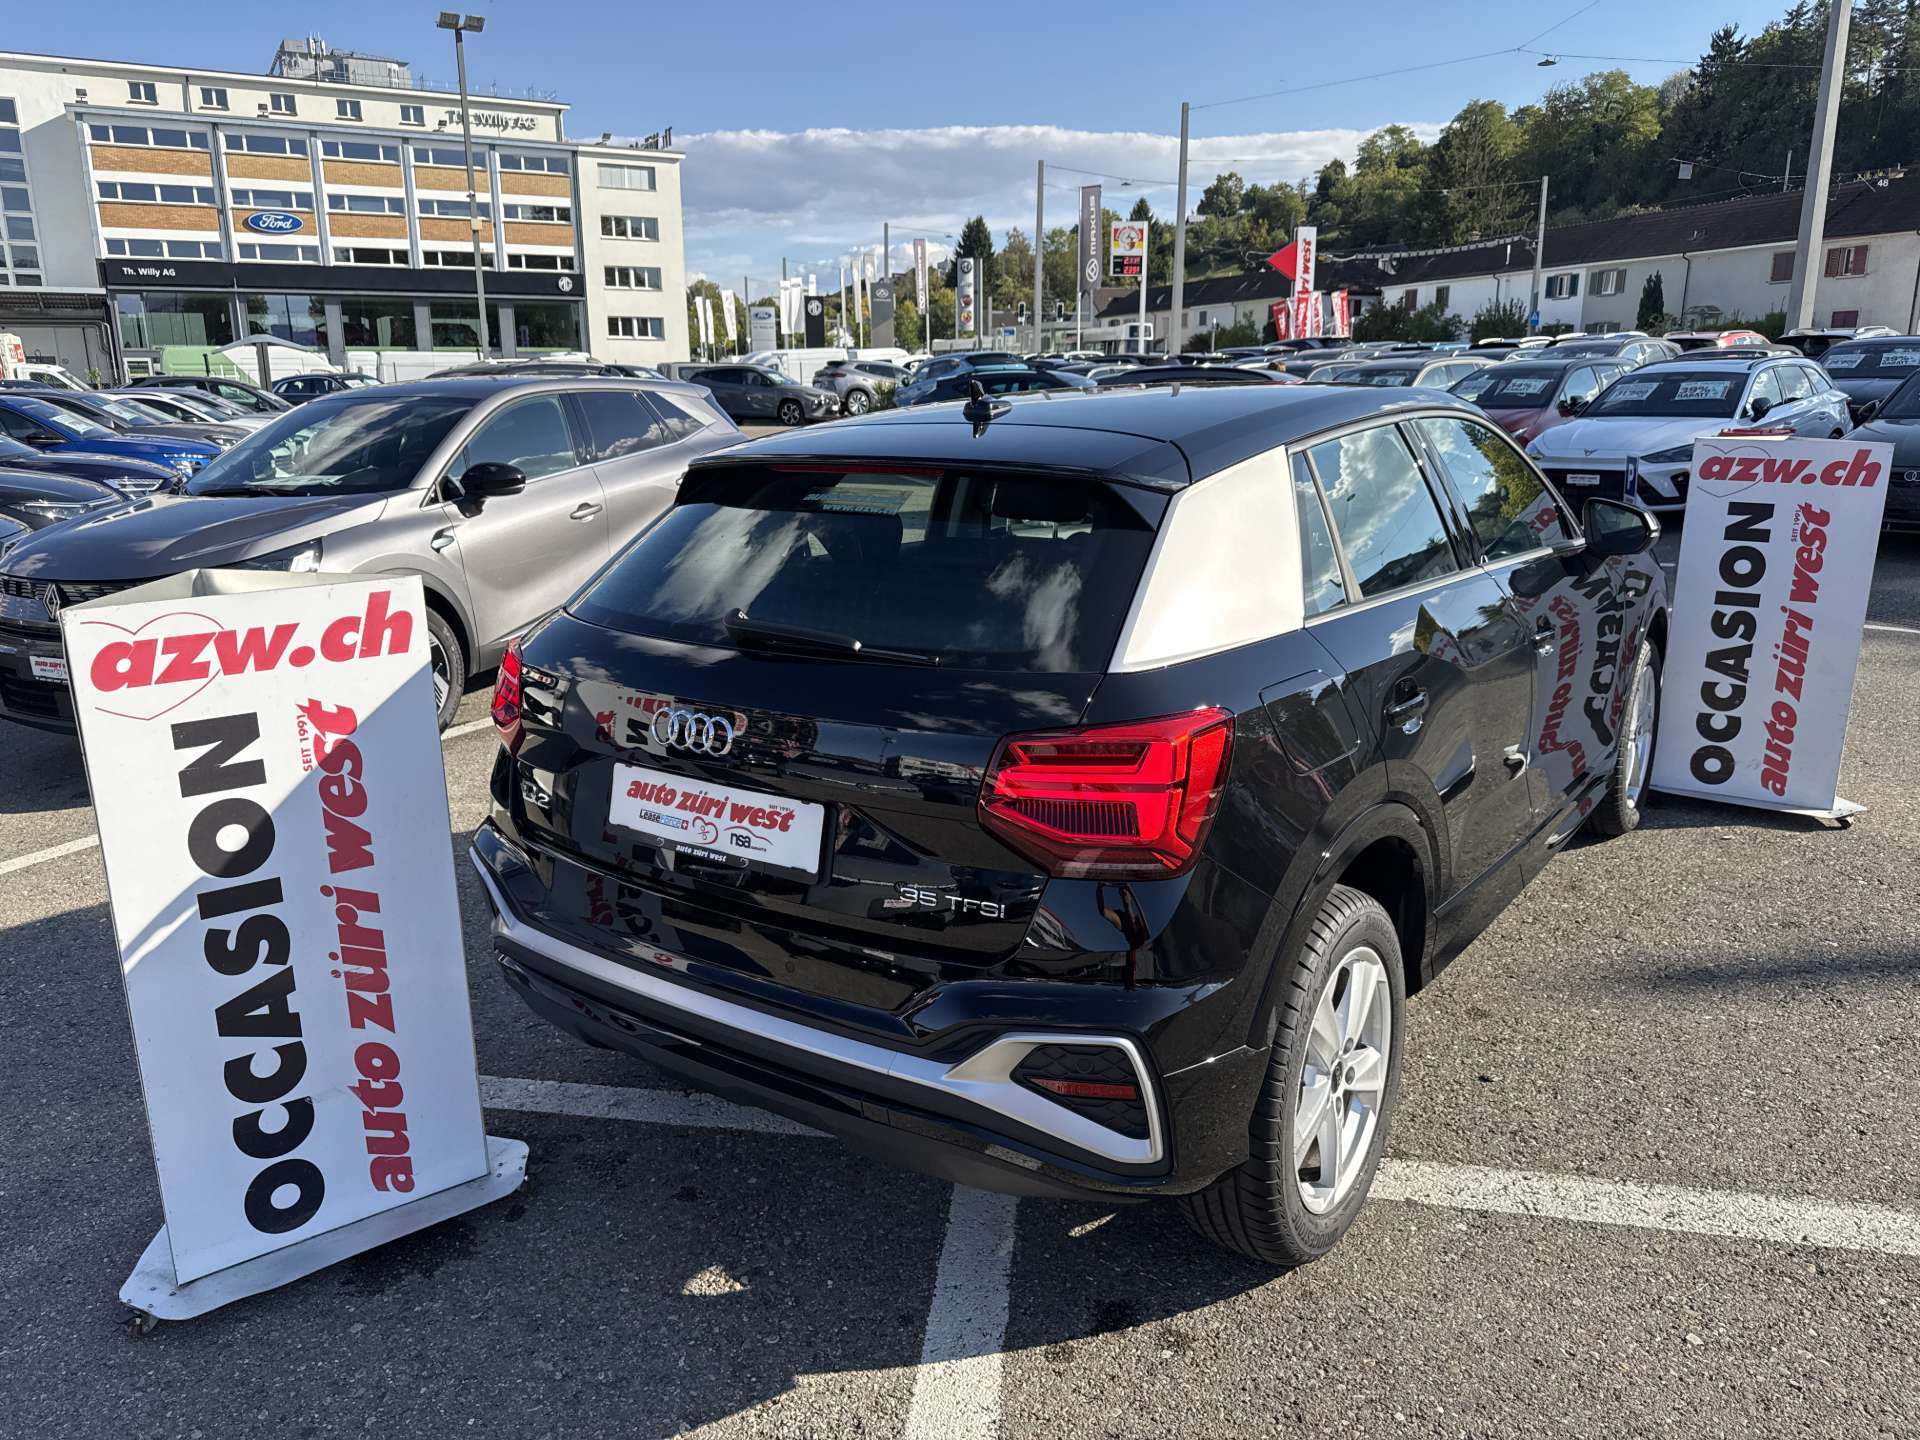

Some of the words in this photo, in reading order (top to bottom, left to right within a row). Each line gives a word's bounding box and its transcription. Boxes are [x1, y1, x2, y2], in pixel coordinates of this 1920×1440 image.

[259, 214, 293, 229] Ford
[122, 267, 137, 276] Th.
[138, 268, 160, 277] Willy
[162, 269, 176, 277] AG
[1681, 385, 1711, 394] 39%
[1627, 463, 1635, 490] P
[1699, 449, 1882, 488] azw.ch
[1789, 502, 1832, 604] west
[90, 590, 414, 692] azw.ch
[1690, 501, 1776, 785] OCCASION
[1772, 606, 1814, 702] züri
[296, 714, 309, 743] 1991
[1760, 700, 1798, 797] auto
[301, 748, 314, 773] SEIT
[296, 698, 375, 874] west
[626, 780, 678, 807] auto
[675, 790, 730, 819] züri
[729, 802, 796, 832] west
[675, 844, 691, 854] auto
[709, 852, 727, 862] west
[729, 832, 751, 849] nsa
[900, 887, 937, 907] 35
[945, 895, 1005, 919] TFSI
[171, 712, 325, 1234] OCCASION
[320, 884, 396, 1034] züri
[347, 1041, 416, 1194] auto
